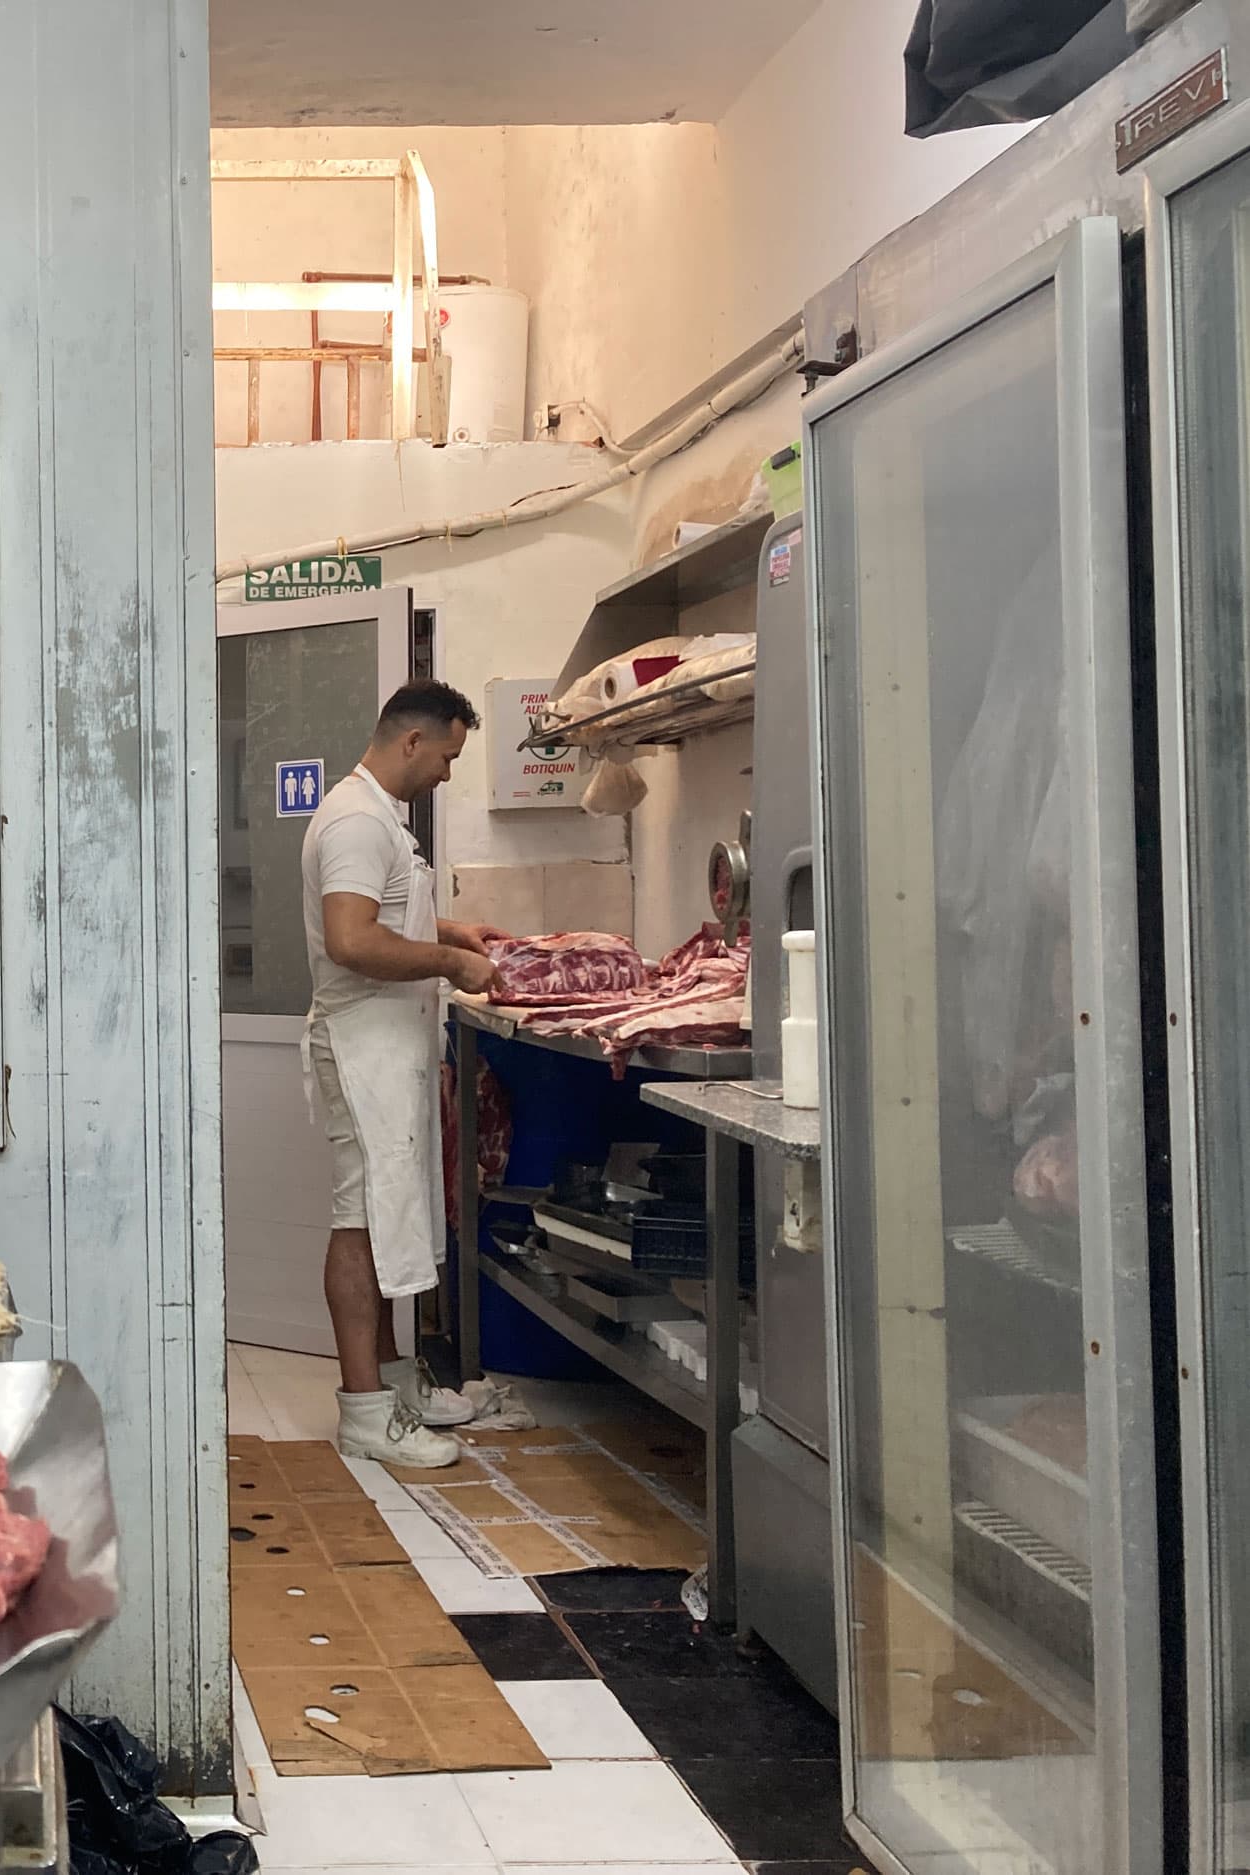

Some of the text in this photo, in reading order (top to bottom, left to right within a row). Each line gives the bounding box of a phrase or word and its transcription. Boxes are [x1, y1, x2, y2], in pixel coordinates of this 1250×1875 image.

[1119, 58, 1217, 147] TREVI
[249, 561, 364, 585] SALIDA
[249, 586, 270, 598] DE
[520, 693, 548, 704] PRIM
[523, 763, 576, 775] BOTIQUIN
